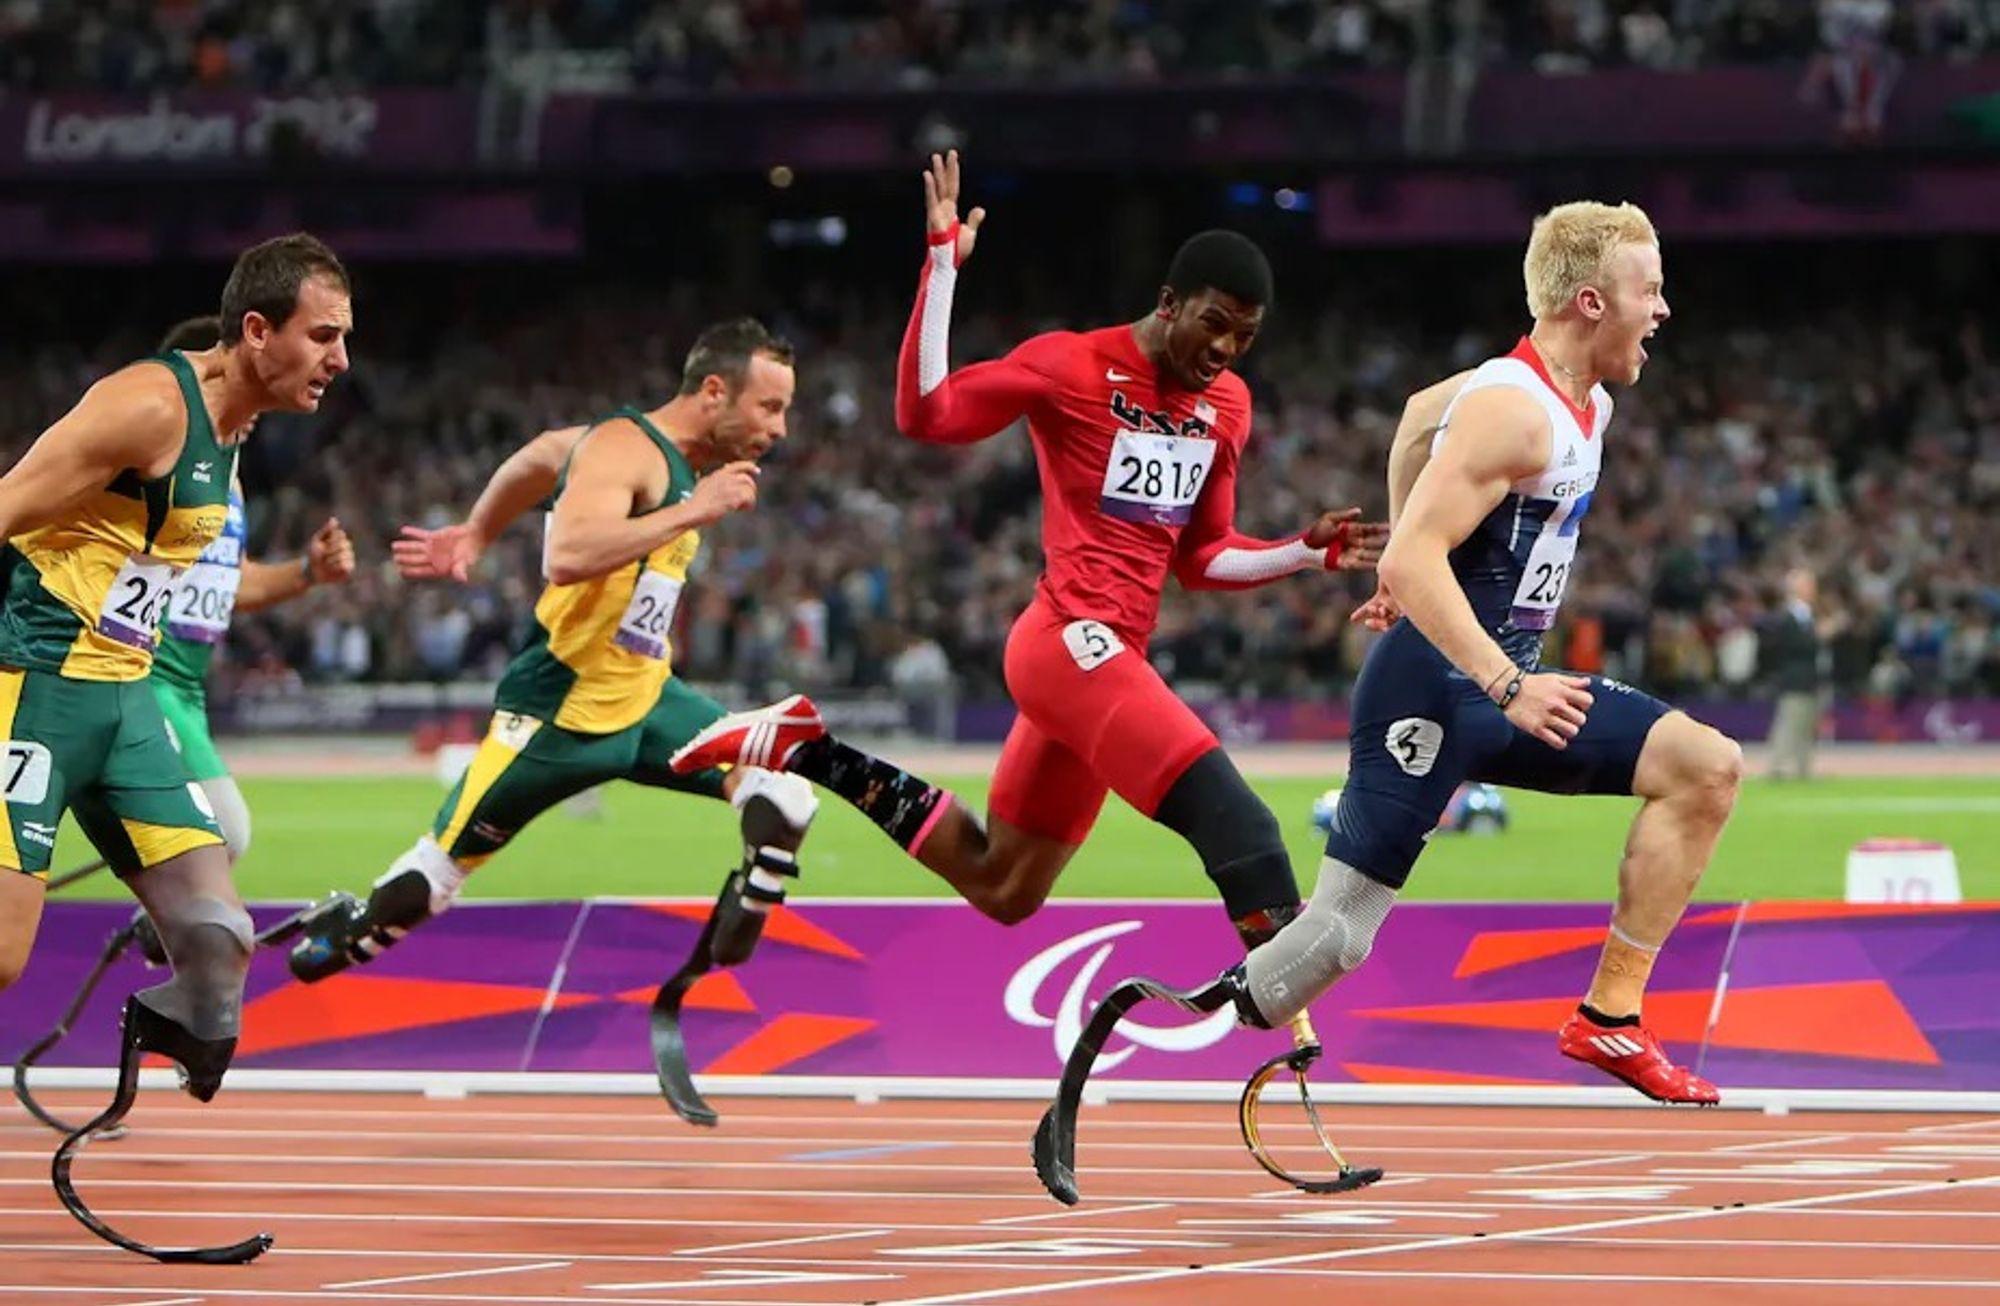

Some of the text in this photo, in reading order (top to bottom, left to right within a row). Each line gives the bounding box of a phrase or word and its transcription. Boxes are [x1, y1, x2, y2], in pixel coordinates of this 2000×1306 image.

[24, 92, 236, 163] London
[1116, 456, 1203, 499] 2818
[1526, 562, 1571, 603] 23
[1082, 623, 1109, 658] 5
[4, 750, 34, 793] 7
